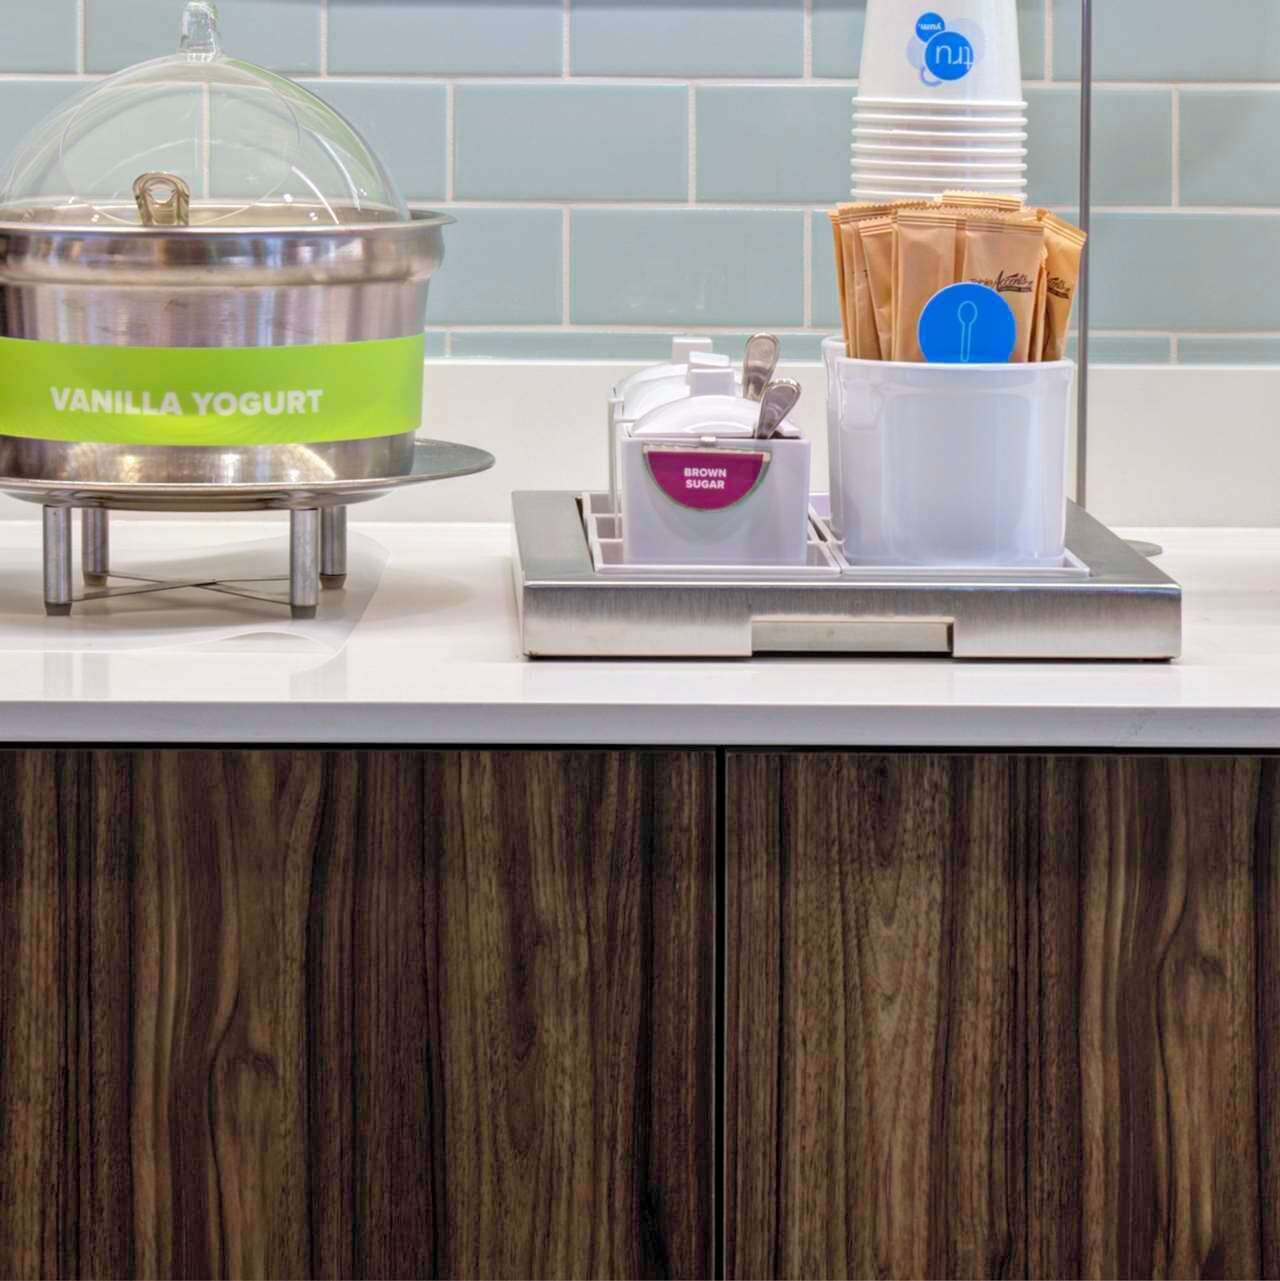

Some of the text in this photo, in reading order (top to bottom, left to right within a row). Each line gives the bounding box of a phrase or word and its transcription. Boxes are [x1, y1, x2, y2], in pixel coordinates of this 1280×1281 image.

[935, 45, 974, 70] tru
[50, 387, 324, 416] VANILLA YOGURT
[683, 467, 727, 478] BROWN
[685, 479, 725, 489] SUGAR
